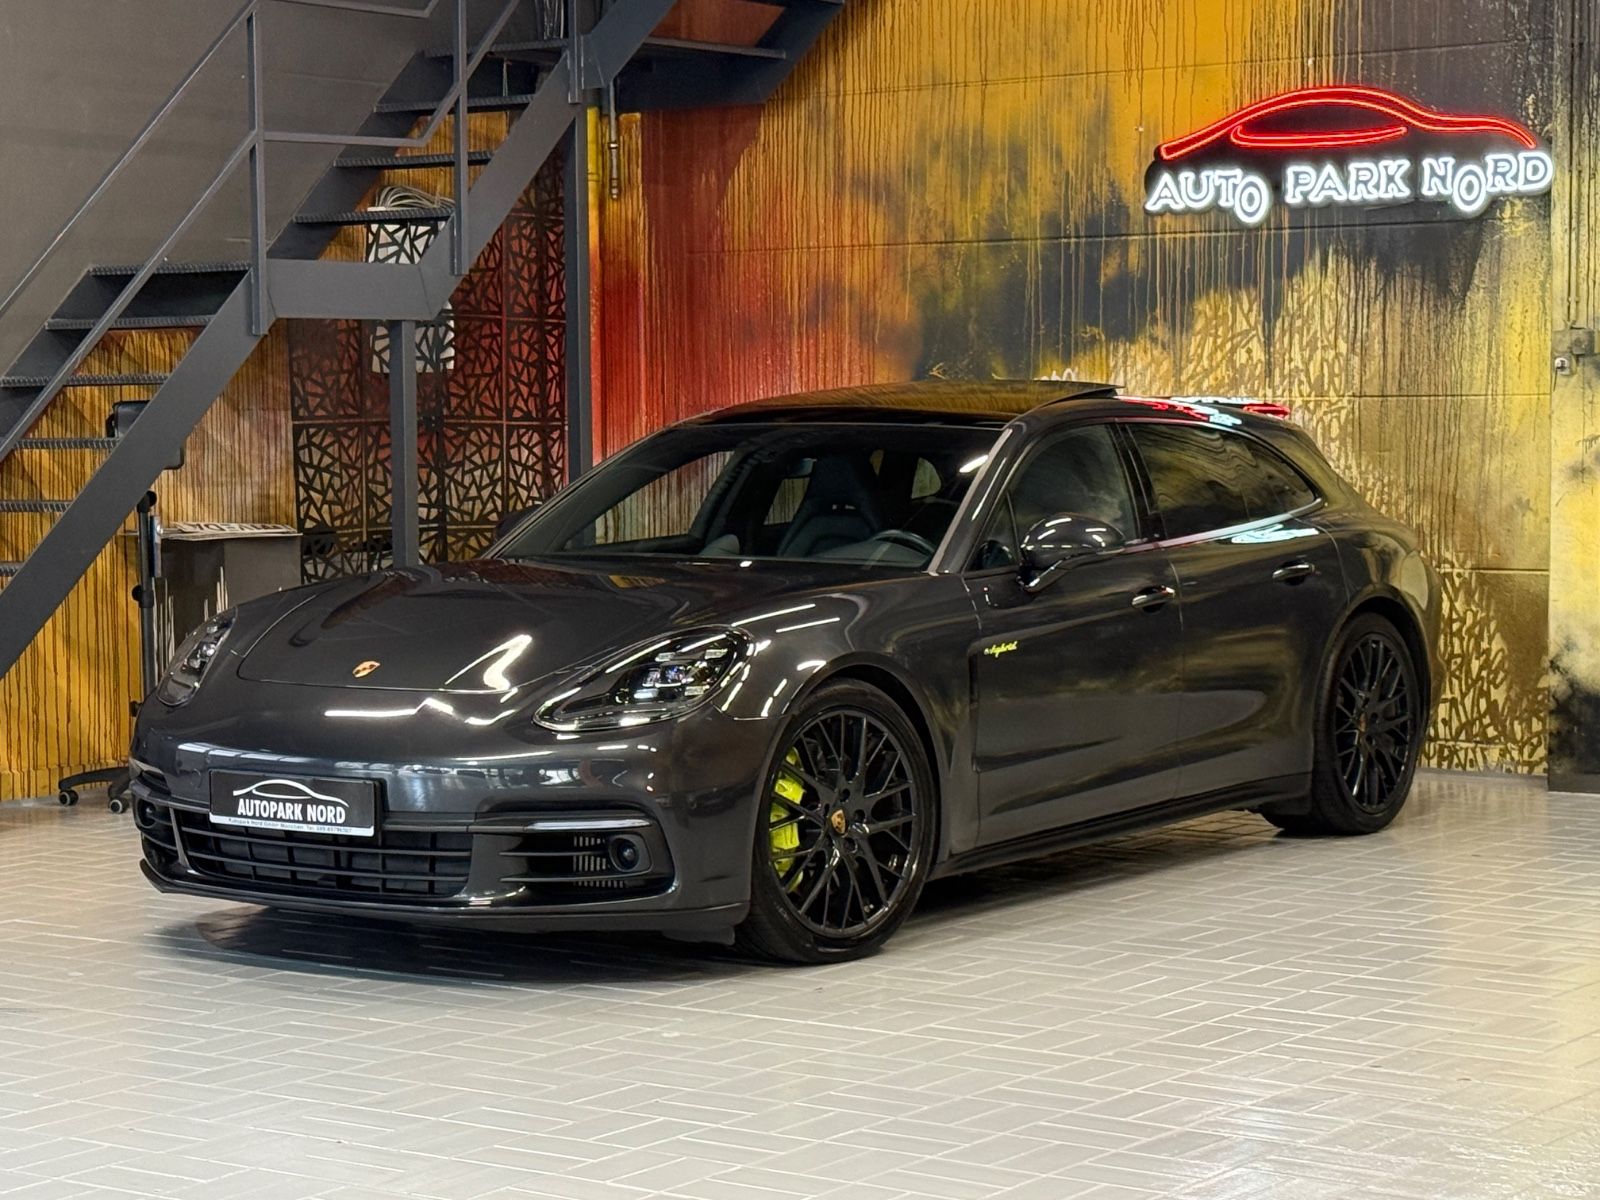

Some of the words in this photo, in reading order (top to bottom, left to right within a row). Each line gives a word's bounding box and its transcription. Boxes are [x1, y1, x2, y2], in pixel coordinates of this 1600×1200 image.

[1145, 170, 1269, 224] AUTO
[1286, 159, 1410, 204] PARK
[1422, 151, 1554, 213] NORD
[237, 798, 303, 821] AUTOPARK
[307, 804, 346, 824] NORD
